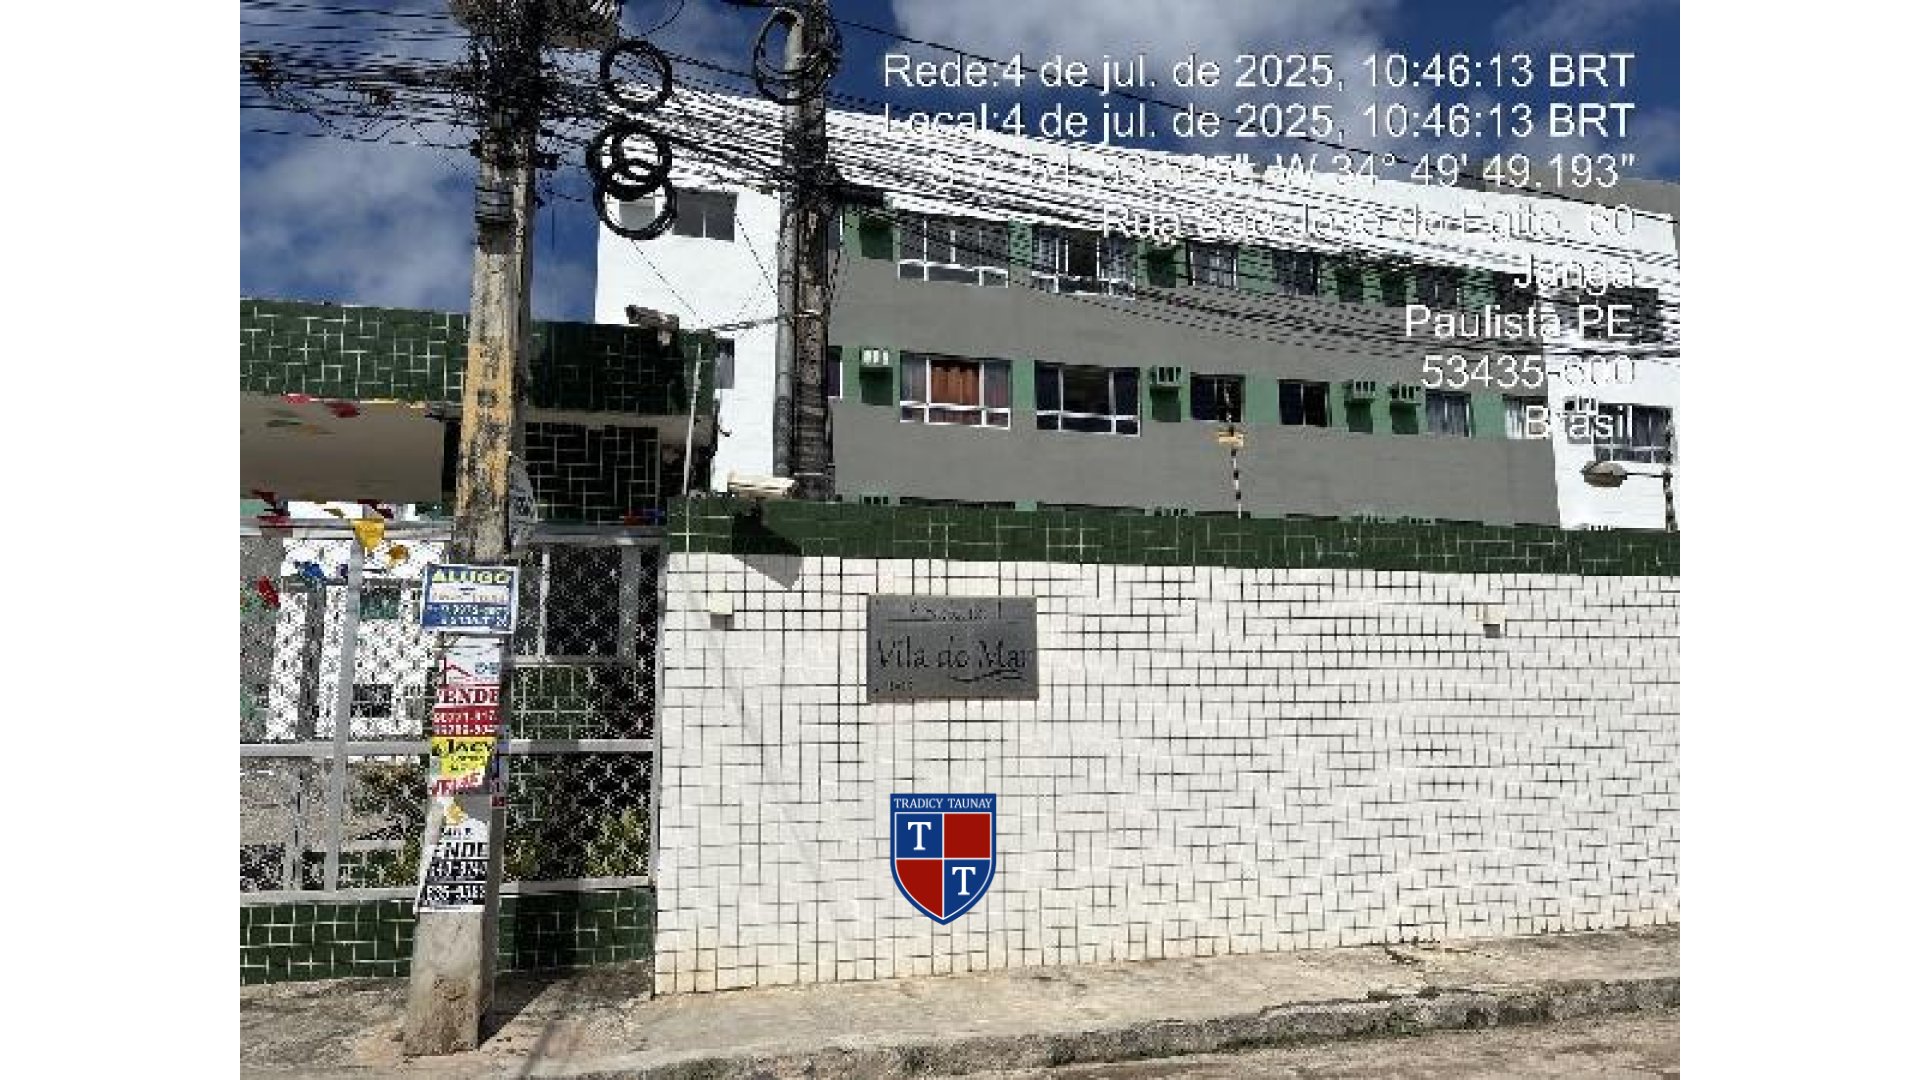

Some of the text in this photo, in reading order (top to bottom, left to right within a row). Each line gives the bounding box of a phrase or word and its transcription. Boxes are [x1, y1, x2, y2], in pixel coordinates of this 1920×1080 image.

[431, 568, 512, 584] ALUGO
[876, 634, 929, 669] Vila
[937, 634, 969, 669] do
